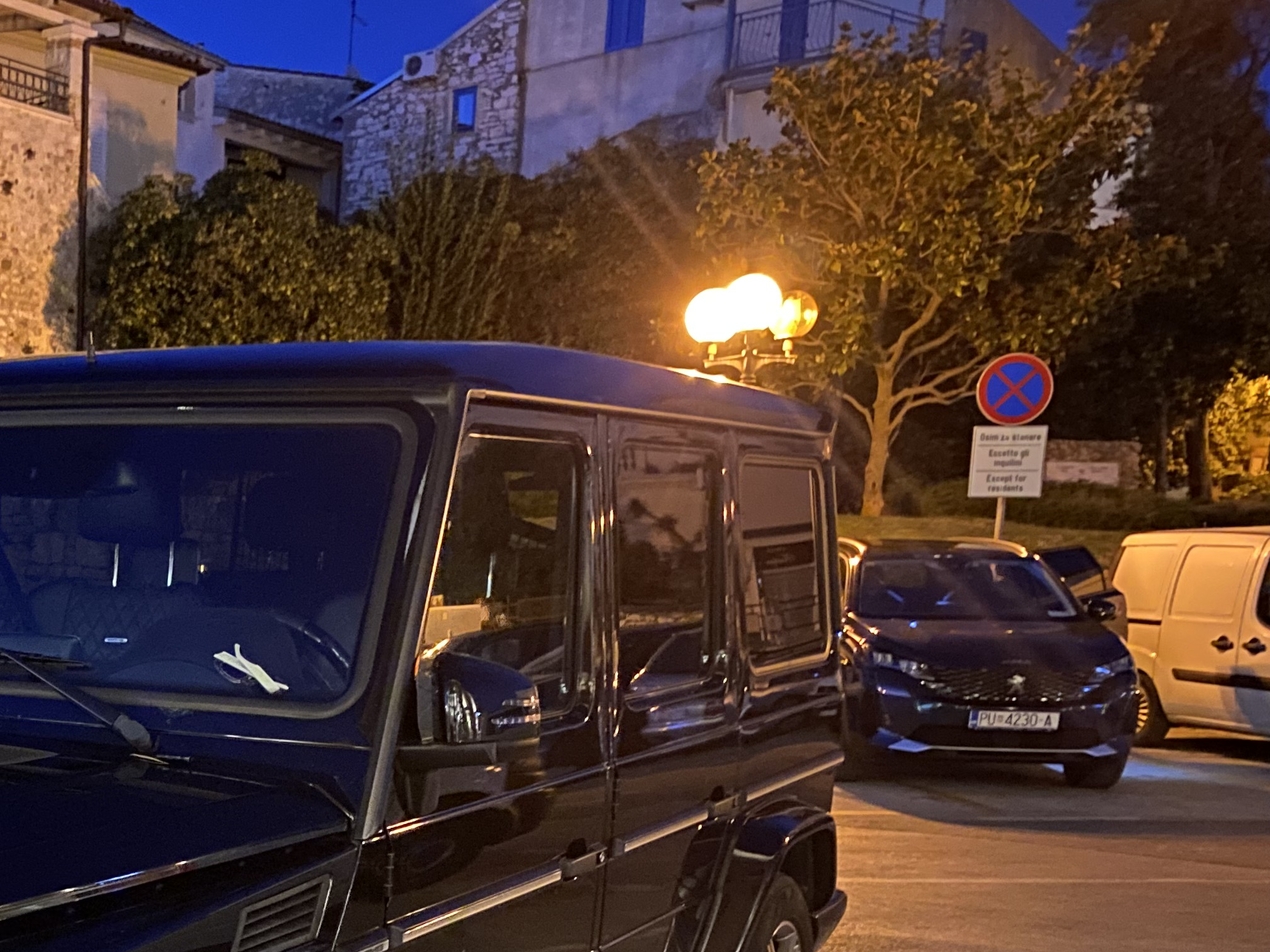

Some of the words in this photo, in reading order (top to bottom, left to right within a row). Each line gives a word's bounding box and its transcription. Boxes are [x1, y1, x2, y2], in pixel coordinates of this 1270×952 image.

[989, 449, 1019, 458] Eccetto
[986, 474, 1012, 484] Except
[1015, 474, 1027, 482] for
[979, 712, 996, 726] PU
